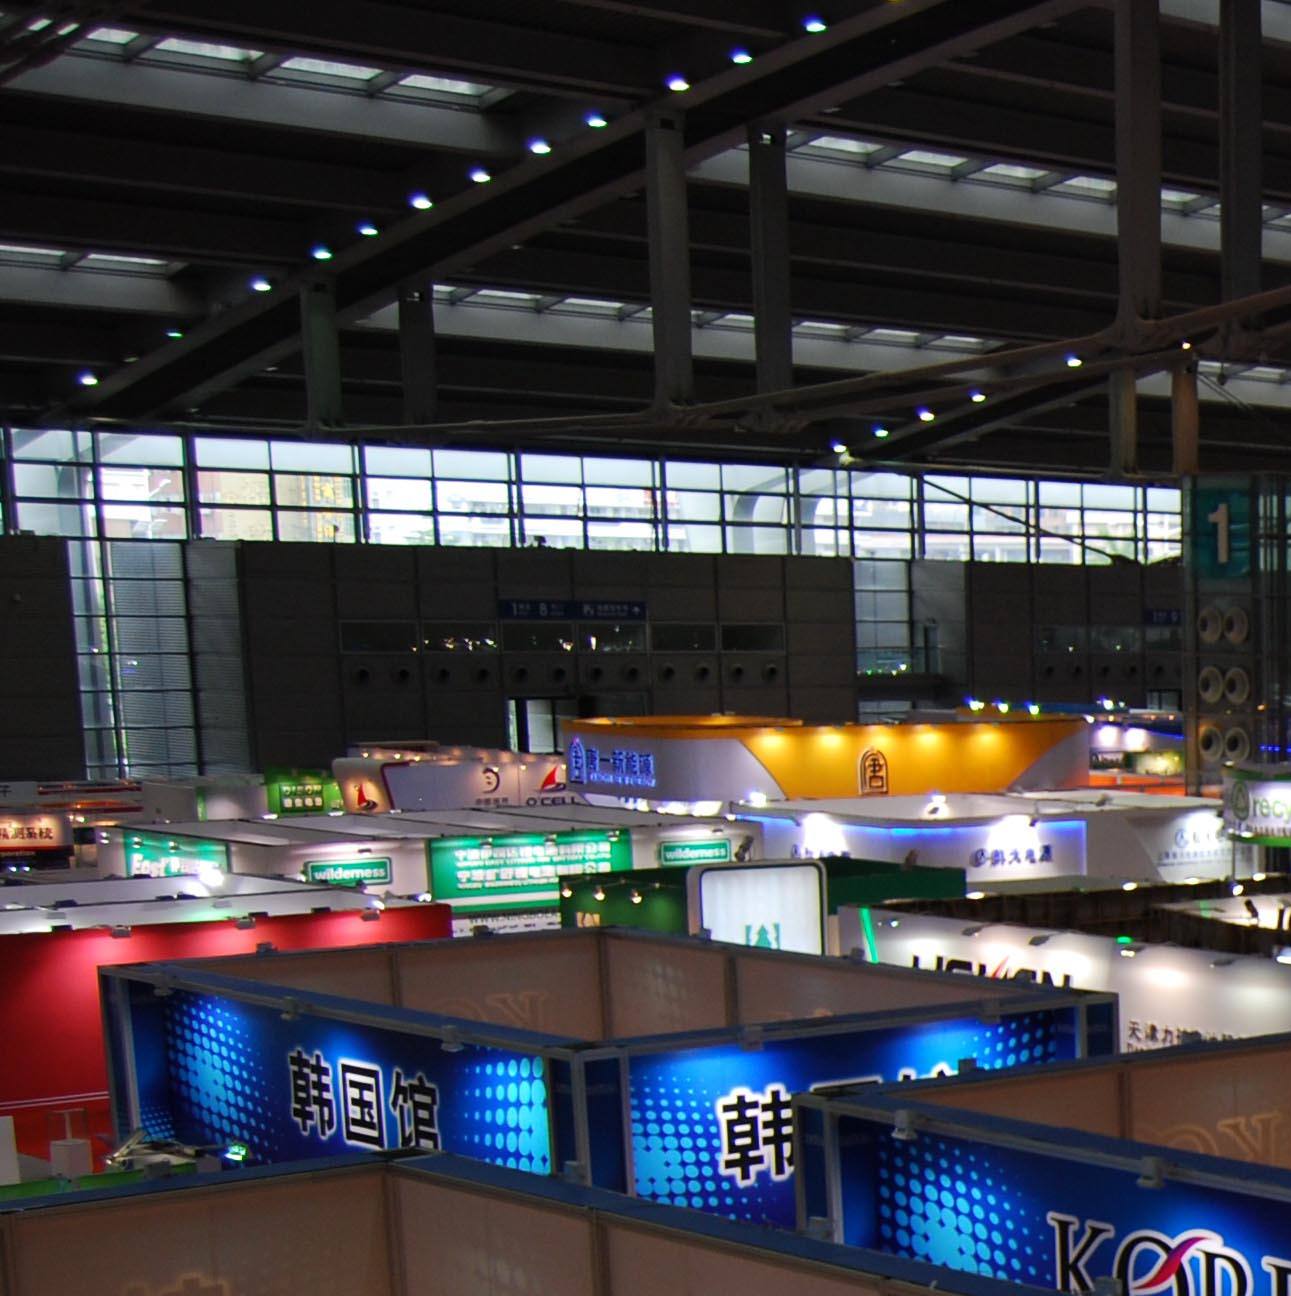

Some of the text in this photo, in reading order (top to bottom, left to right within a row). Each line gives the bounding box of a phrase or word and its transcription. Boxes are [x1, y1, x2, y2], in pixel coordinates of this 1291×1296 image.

[664, 846, 727, 862] wilderness
[314, 865, 386, 881] wilderness
[288, 1047, 441, 1152] 韩国馆
